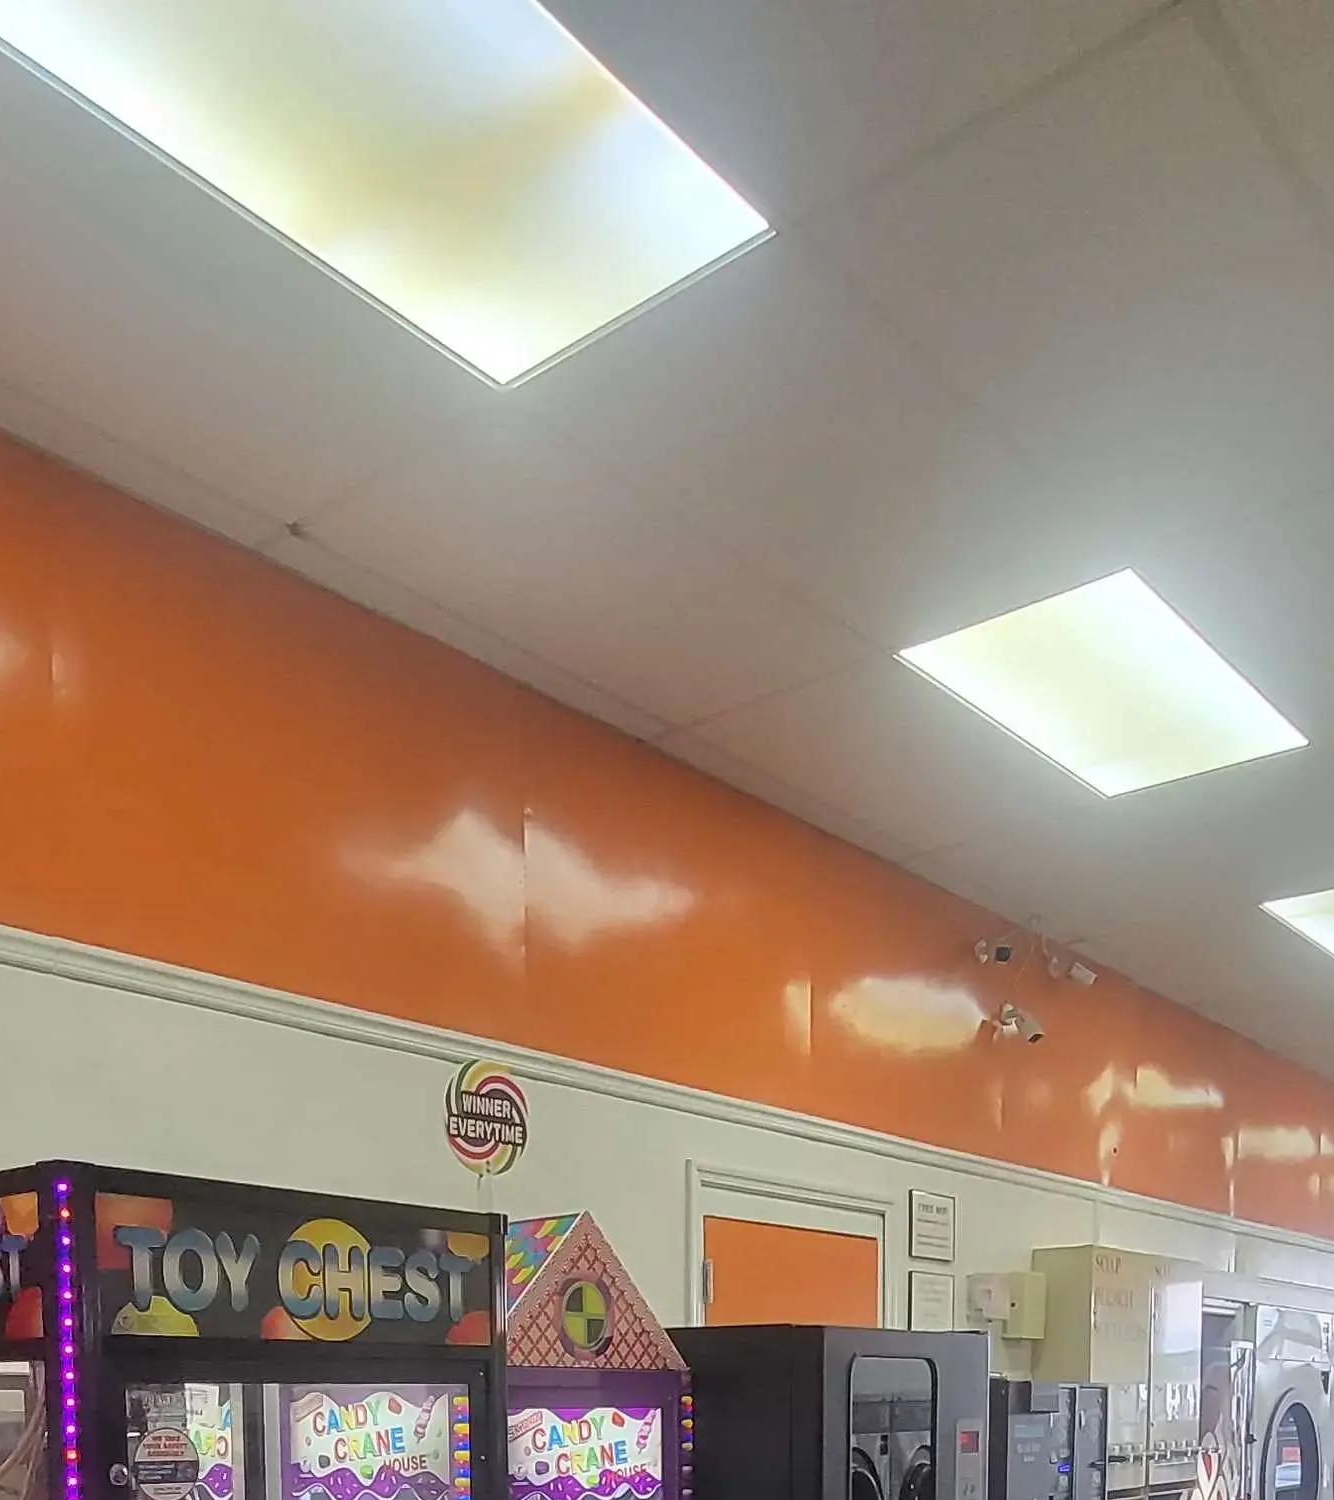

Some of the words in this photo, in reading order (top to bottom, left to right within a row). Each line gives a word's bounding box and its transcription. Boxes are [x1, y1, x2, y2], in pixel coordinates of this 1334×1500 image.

[461, 1092, 512, 1119] WINNER
[449, 1116, 524, 1144] EVERYTIME
[113, 1226, 261, 1312] TOY
[278, 1236, 485, 1322] CHEST
[312, 1399, 382, 1437] CANDY
[531, 1415, 606, 1453] CANDY
[334, 1426, 406, 1463] CRANE
[556, 1440, 629, 1476] CRANE
[383, 1454, 428, 1474] HOUSE
